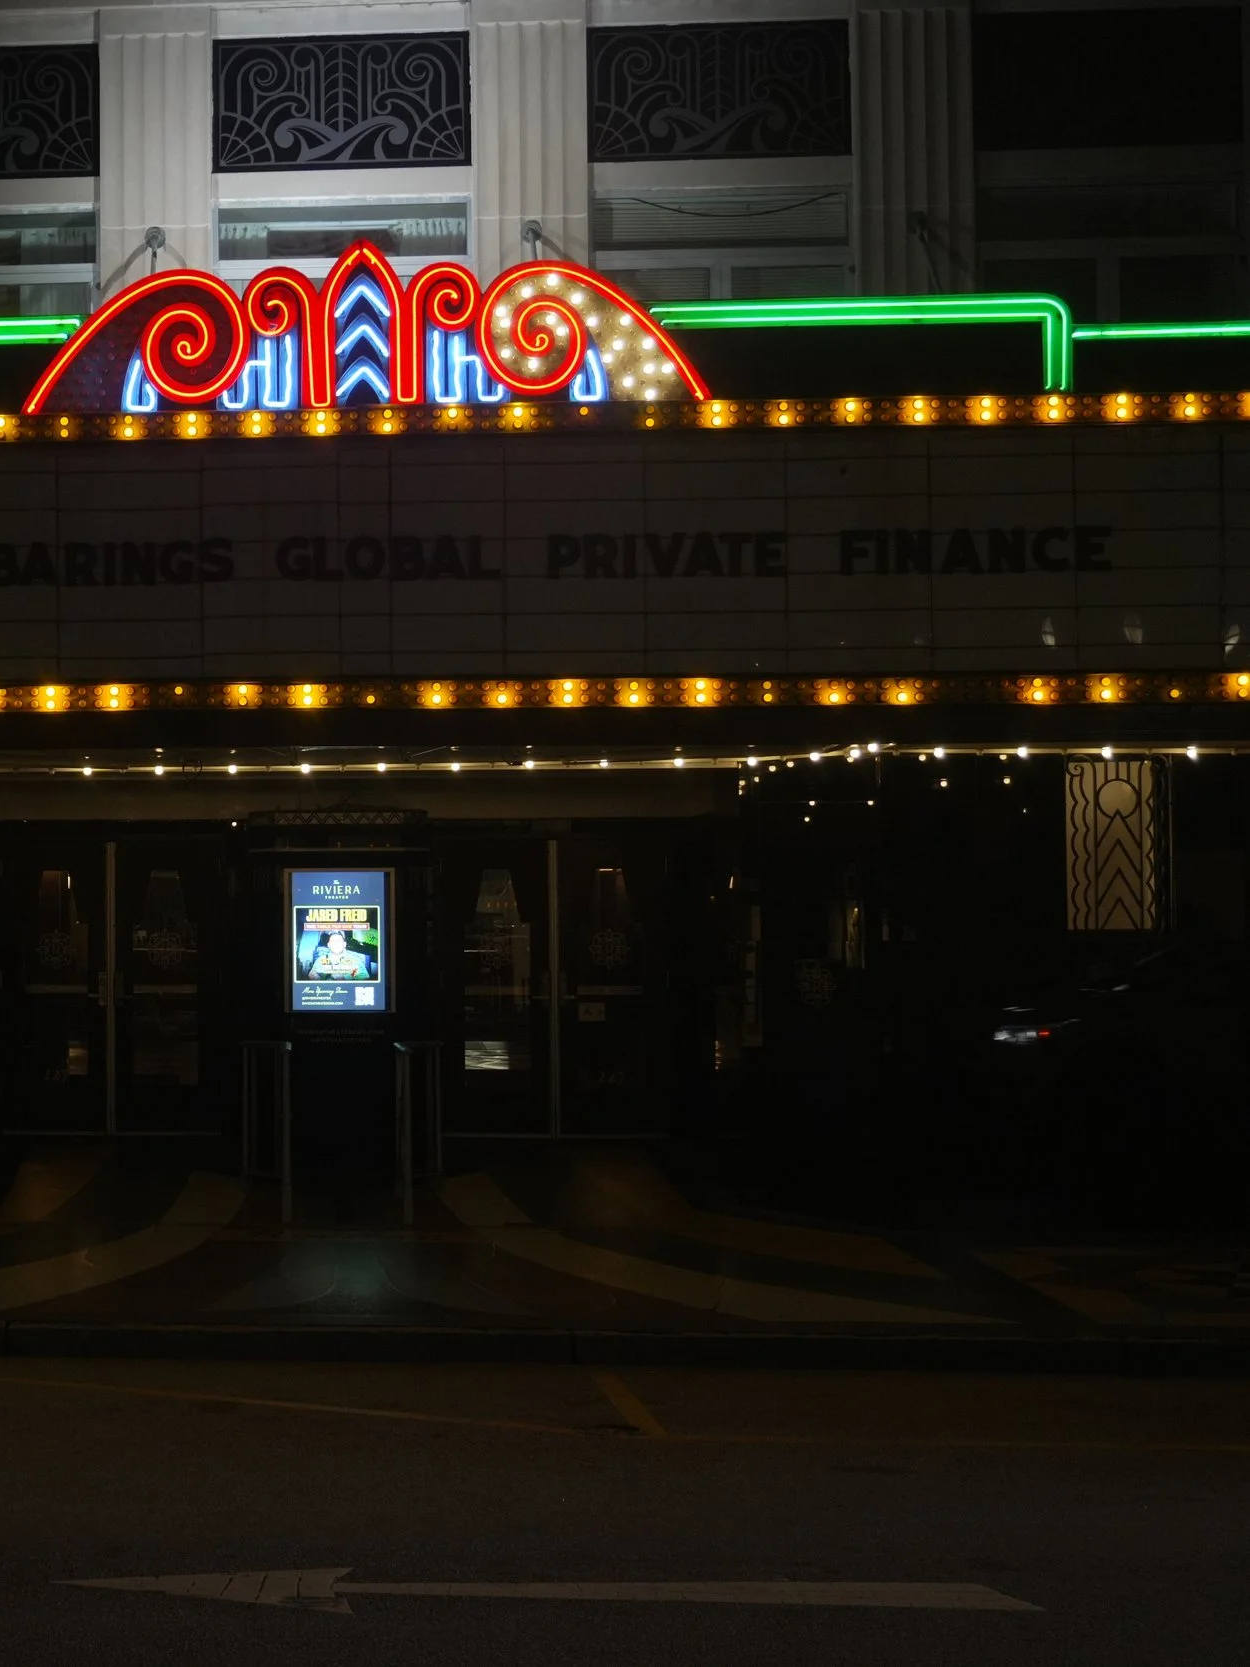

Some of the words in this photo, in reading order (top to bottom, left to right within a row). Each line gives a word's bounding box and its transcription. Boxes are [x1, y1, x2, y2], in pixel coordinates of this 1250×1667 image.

[276, 535, 501, 582] GLOBAL
[547, 531, 787, 579] PRIVATE
[839, 525, 1112, 576] FINANCE
[312, 885, 361, 895] RIVIERA
[305, 908, 338, 922] JARED
